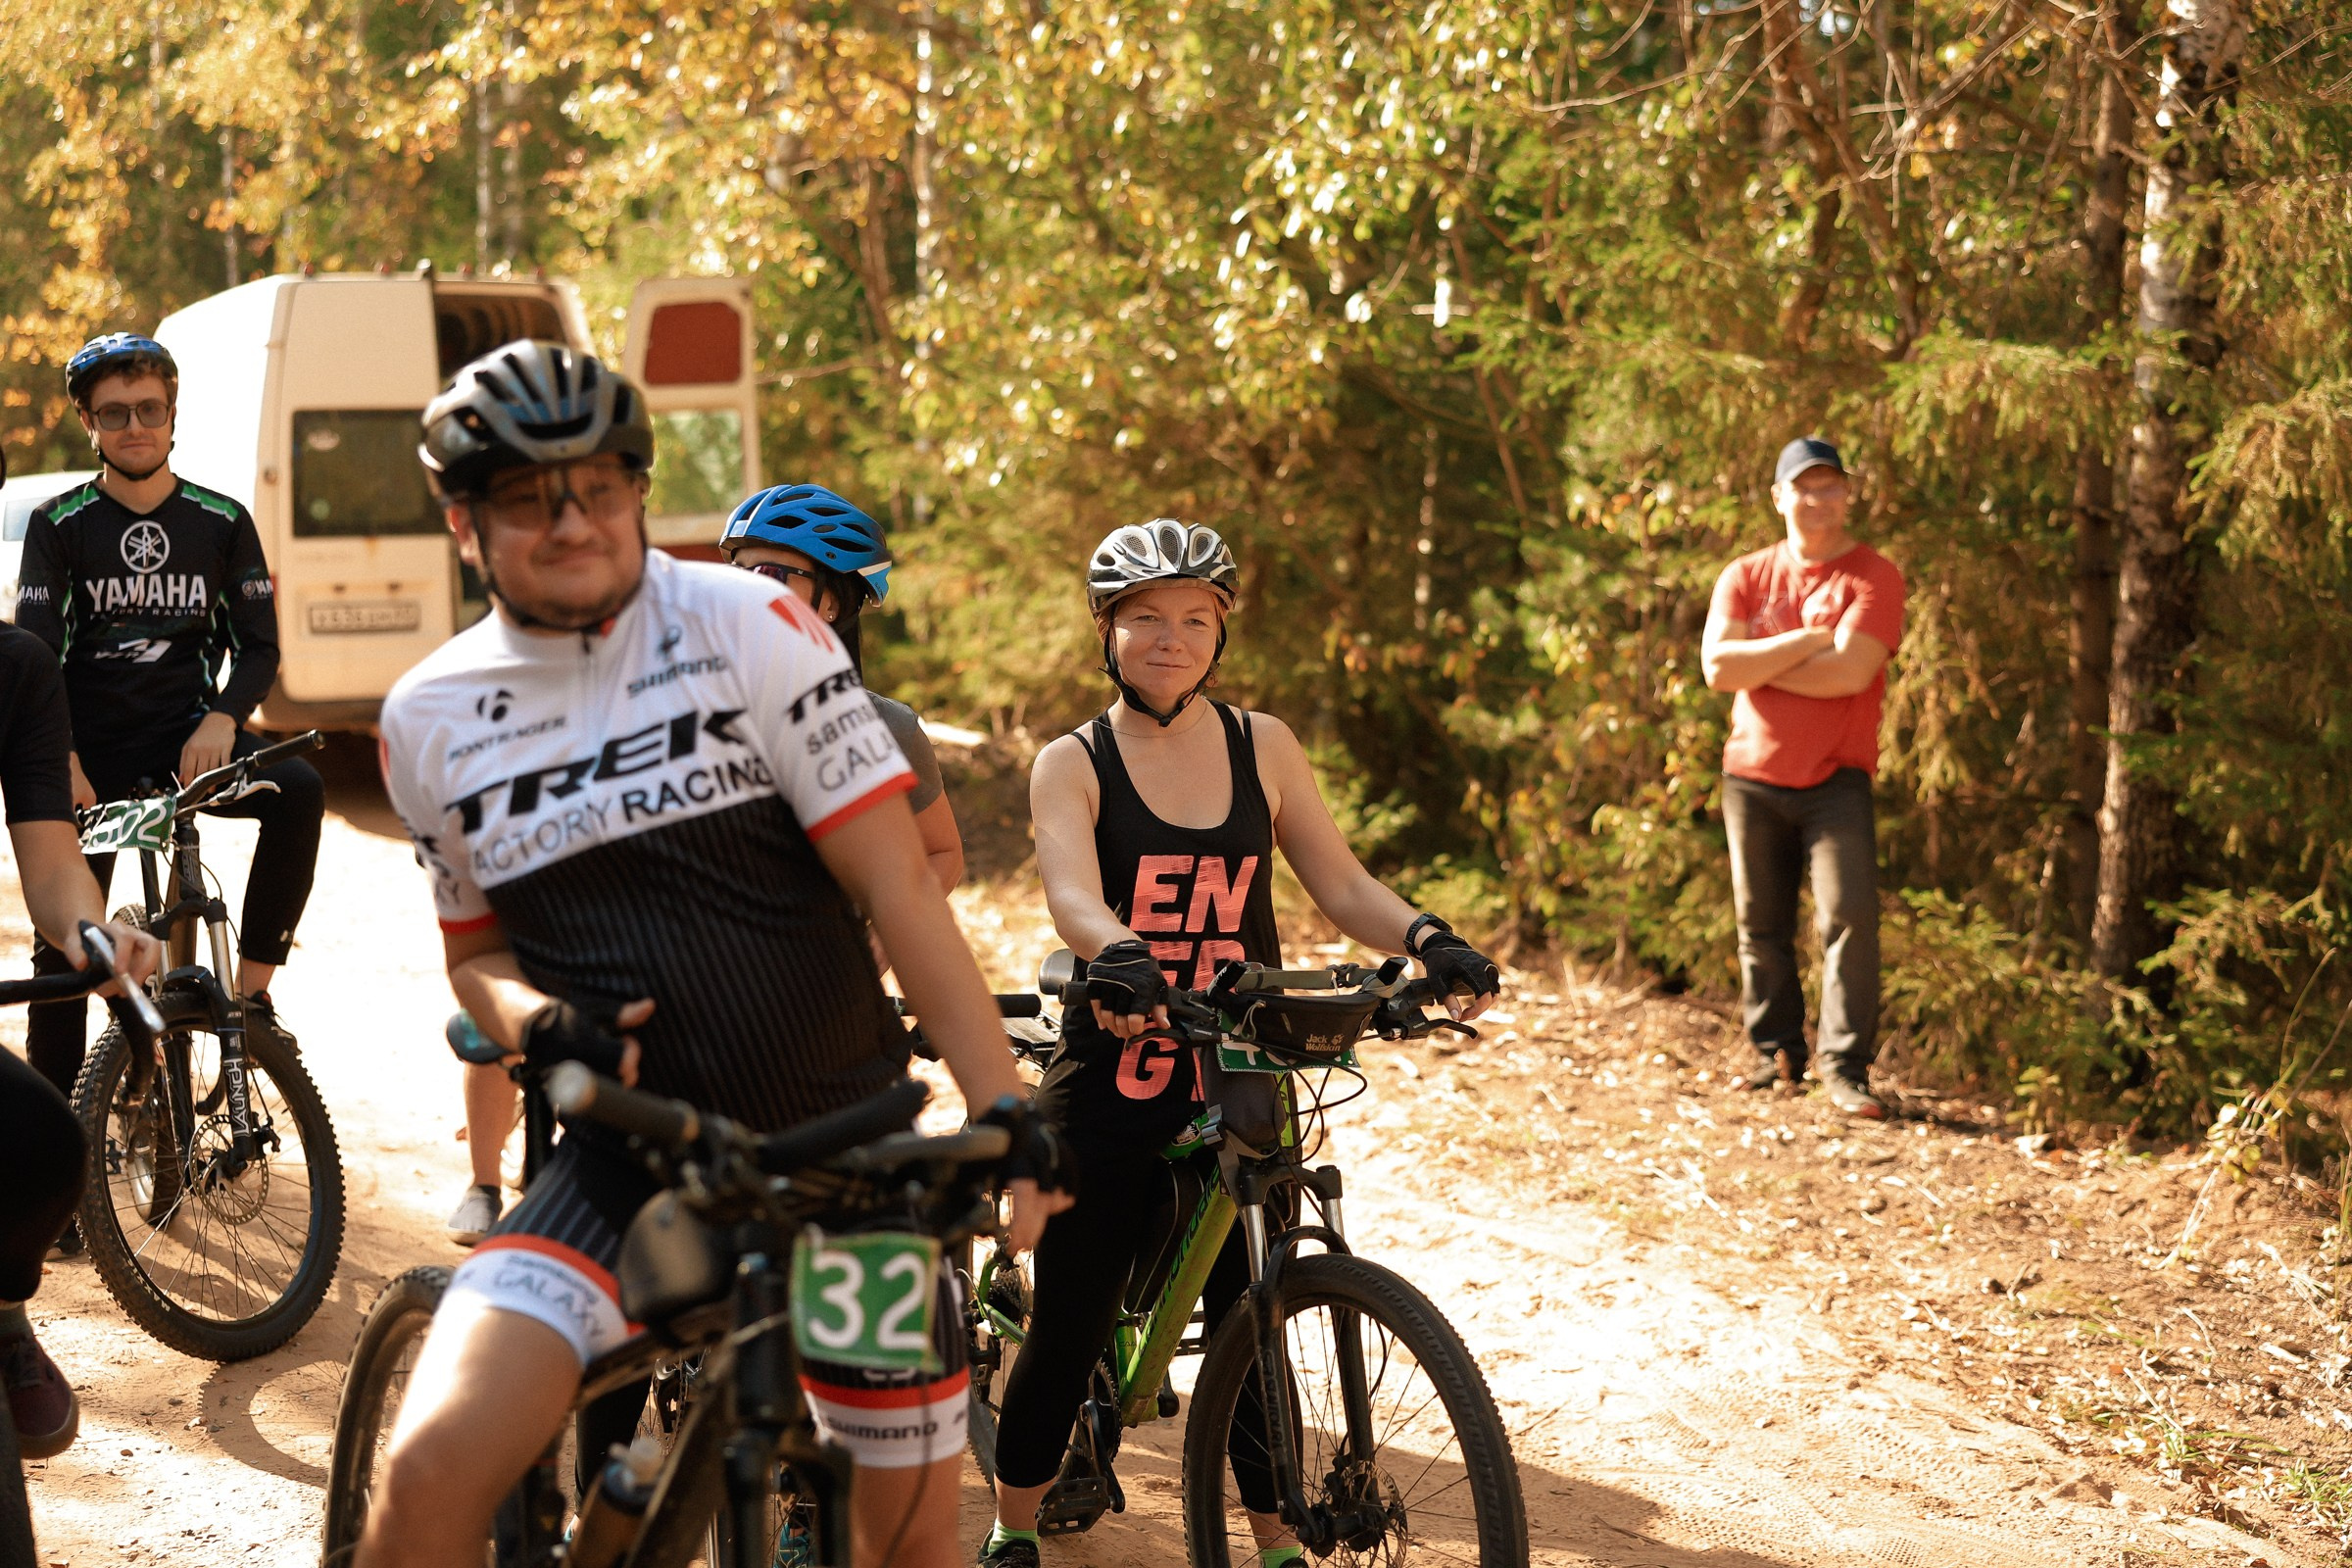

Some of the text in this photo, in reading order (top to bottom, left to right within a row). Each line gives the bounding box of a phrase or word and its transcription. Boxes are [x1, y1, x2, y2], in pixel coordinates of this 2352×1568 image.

[85, 573, 208, 612] YAMAHA
[443, 709, 748, 835] TREK
[474, 798, 612, 872] ACTORY
[1129, 855, 1259, 933] EN
[1304, 1043, 1342, 1052] Wolfskin
[1305, 1034, 1327, 1043] Jack
[222, 1056, 251, 1136] LAUNCH
[808, 1250, 930, 1349] 32
